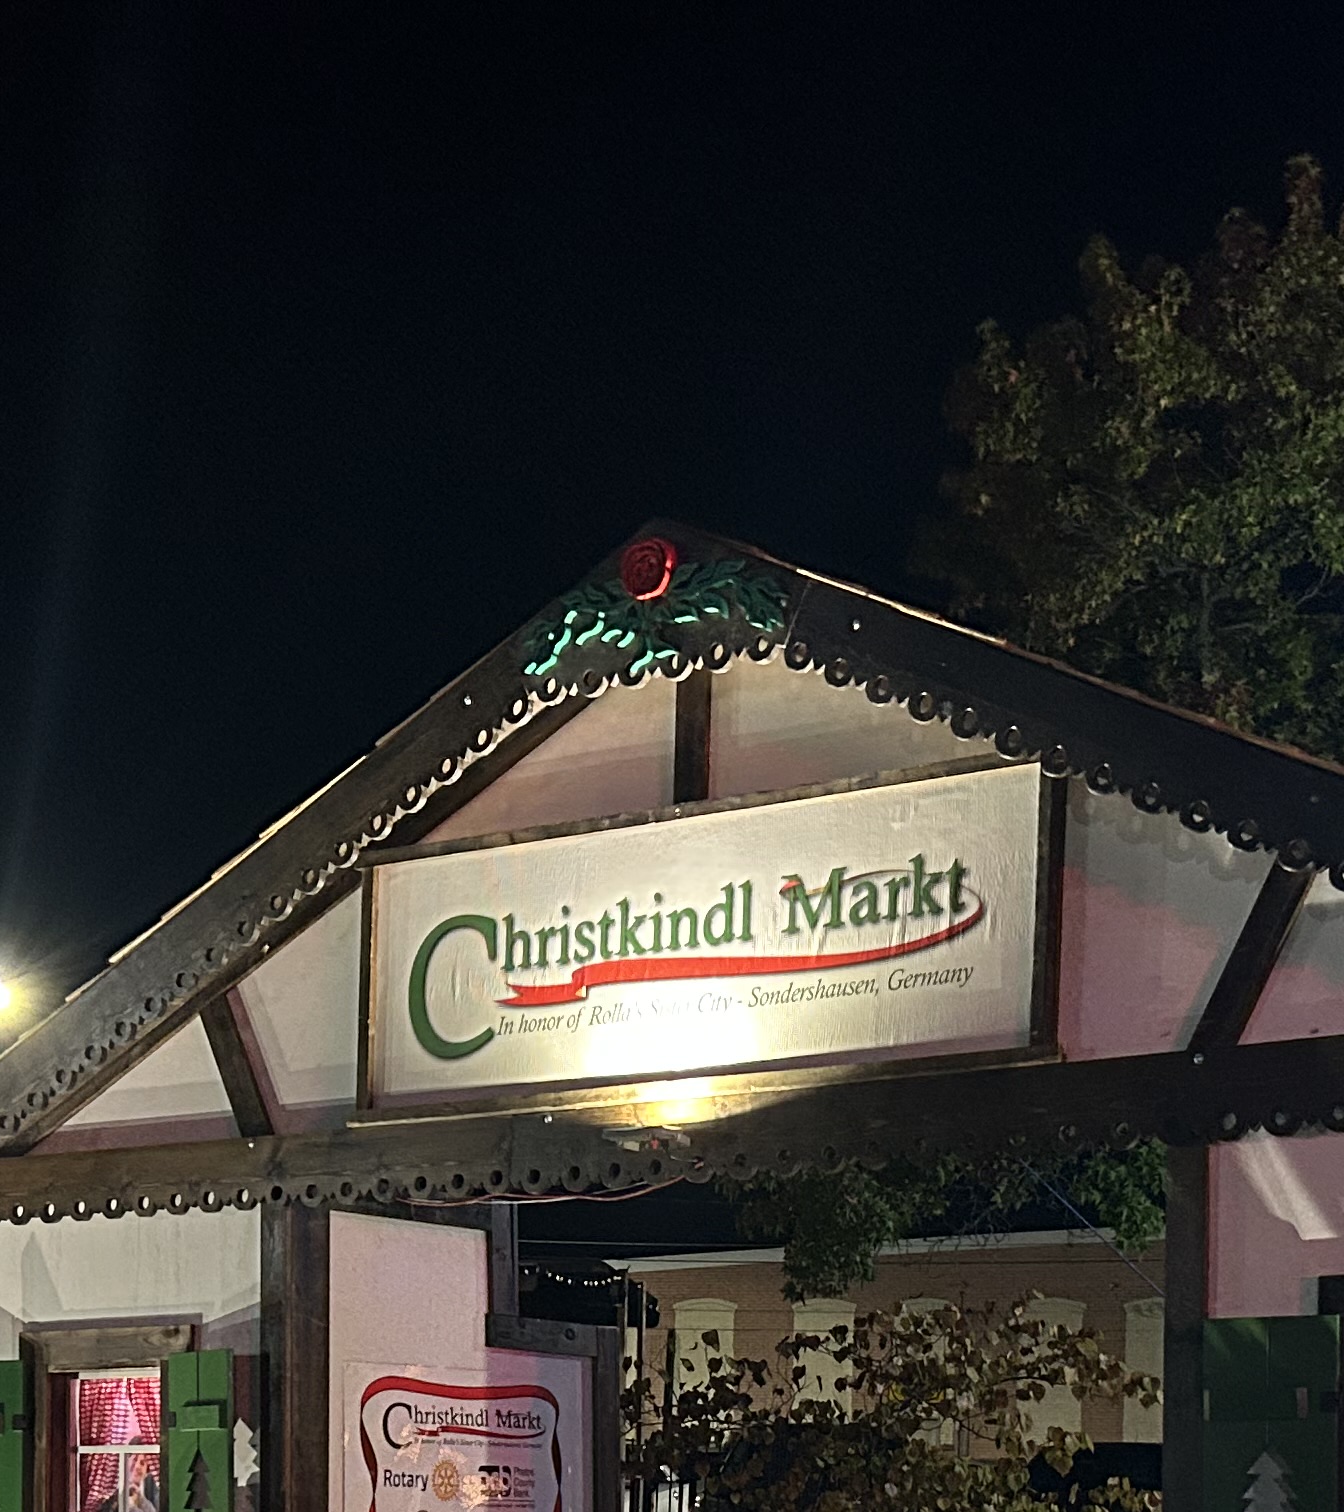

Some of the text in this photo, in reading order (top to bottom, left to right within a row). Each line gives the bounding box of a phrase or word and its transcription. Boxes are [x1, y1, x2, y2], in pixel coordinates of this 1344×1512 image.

[408, 853, 969, 1060] Christkindl Markt
[496, 1016, 515, 1036] In
[518, 1012, 564, 1034] honor
[566, 1006, 583, 1033] of
[697, 992, 733, 1014] City
[747, 975, 879, 1008] Sondershausen,
[887, 965, 974, 993] Germany
[383, 1402, 542, 1450] Christkindl Markt
[384, 1469, 429, 1492] Rotary
